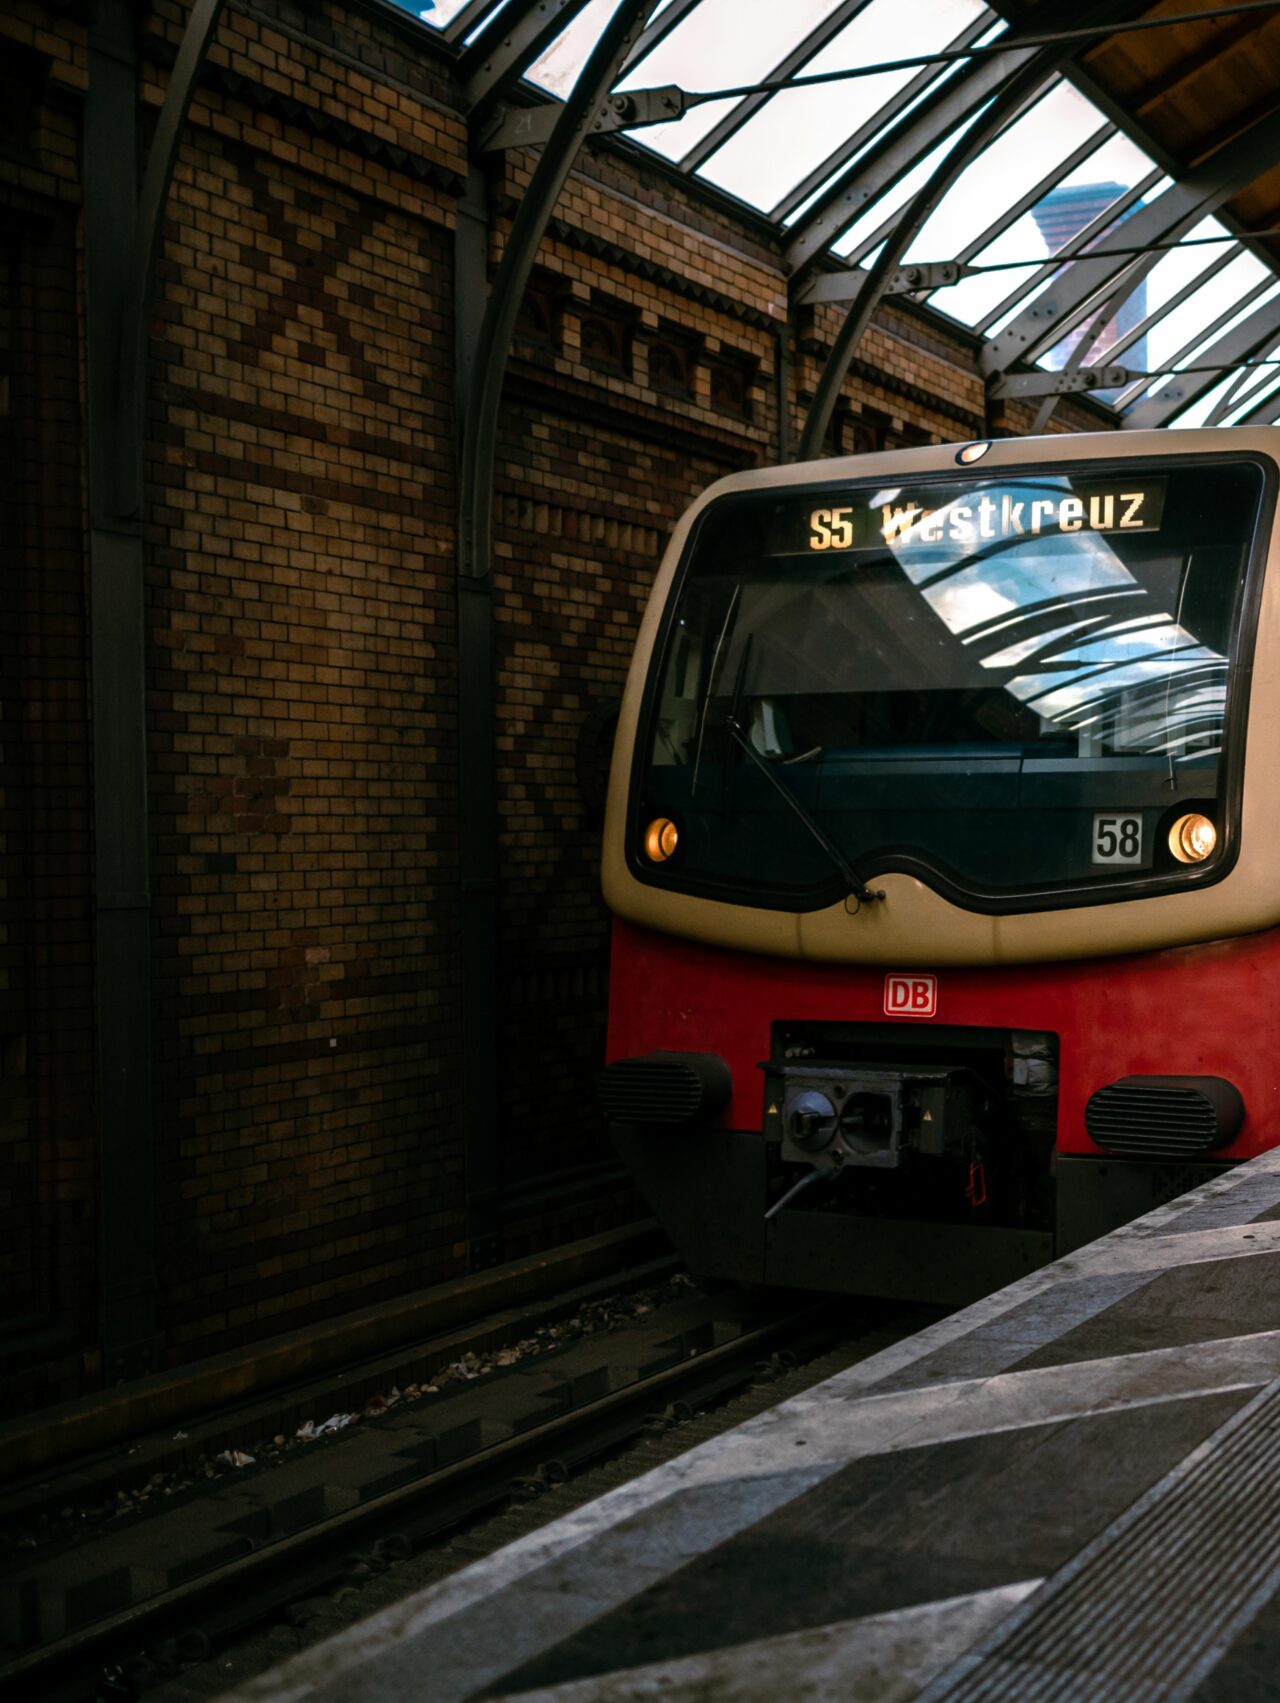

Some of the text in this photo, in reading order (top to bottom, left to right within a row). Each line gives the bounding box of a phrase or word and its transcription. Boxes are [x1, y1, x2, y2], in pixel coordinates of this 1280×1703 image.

[809, 492, 1146, 549] S5 Westkreuz
[1097, 819, 1140, 858] 58
[891, 980, 930, 1010] DB
